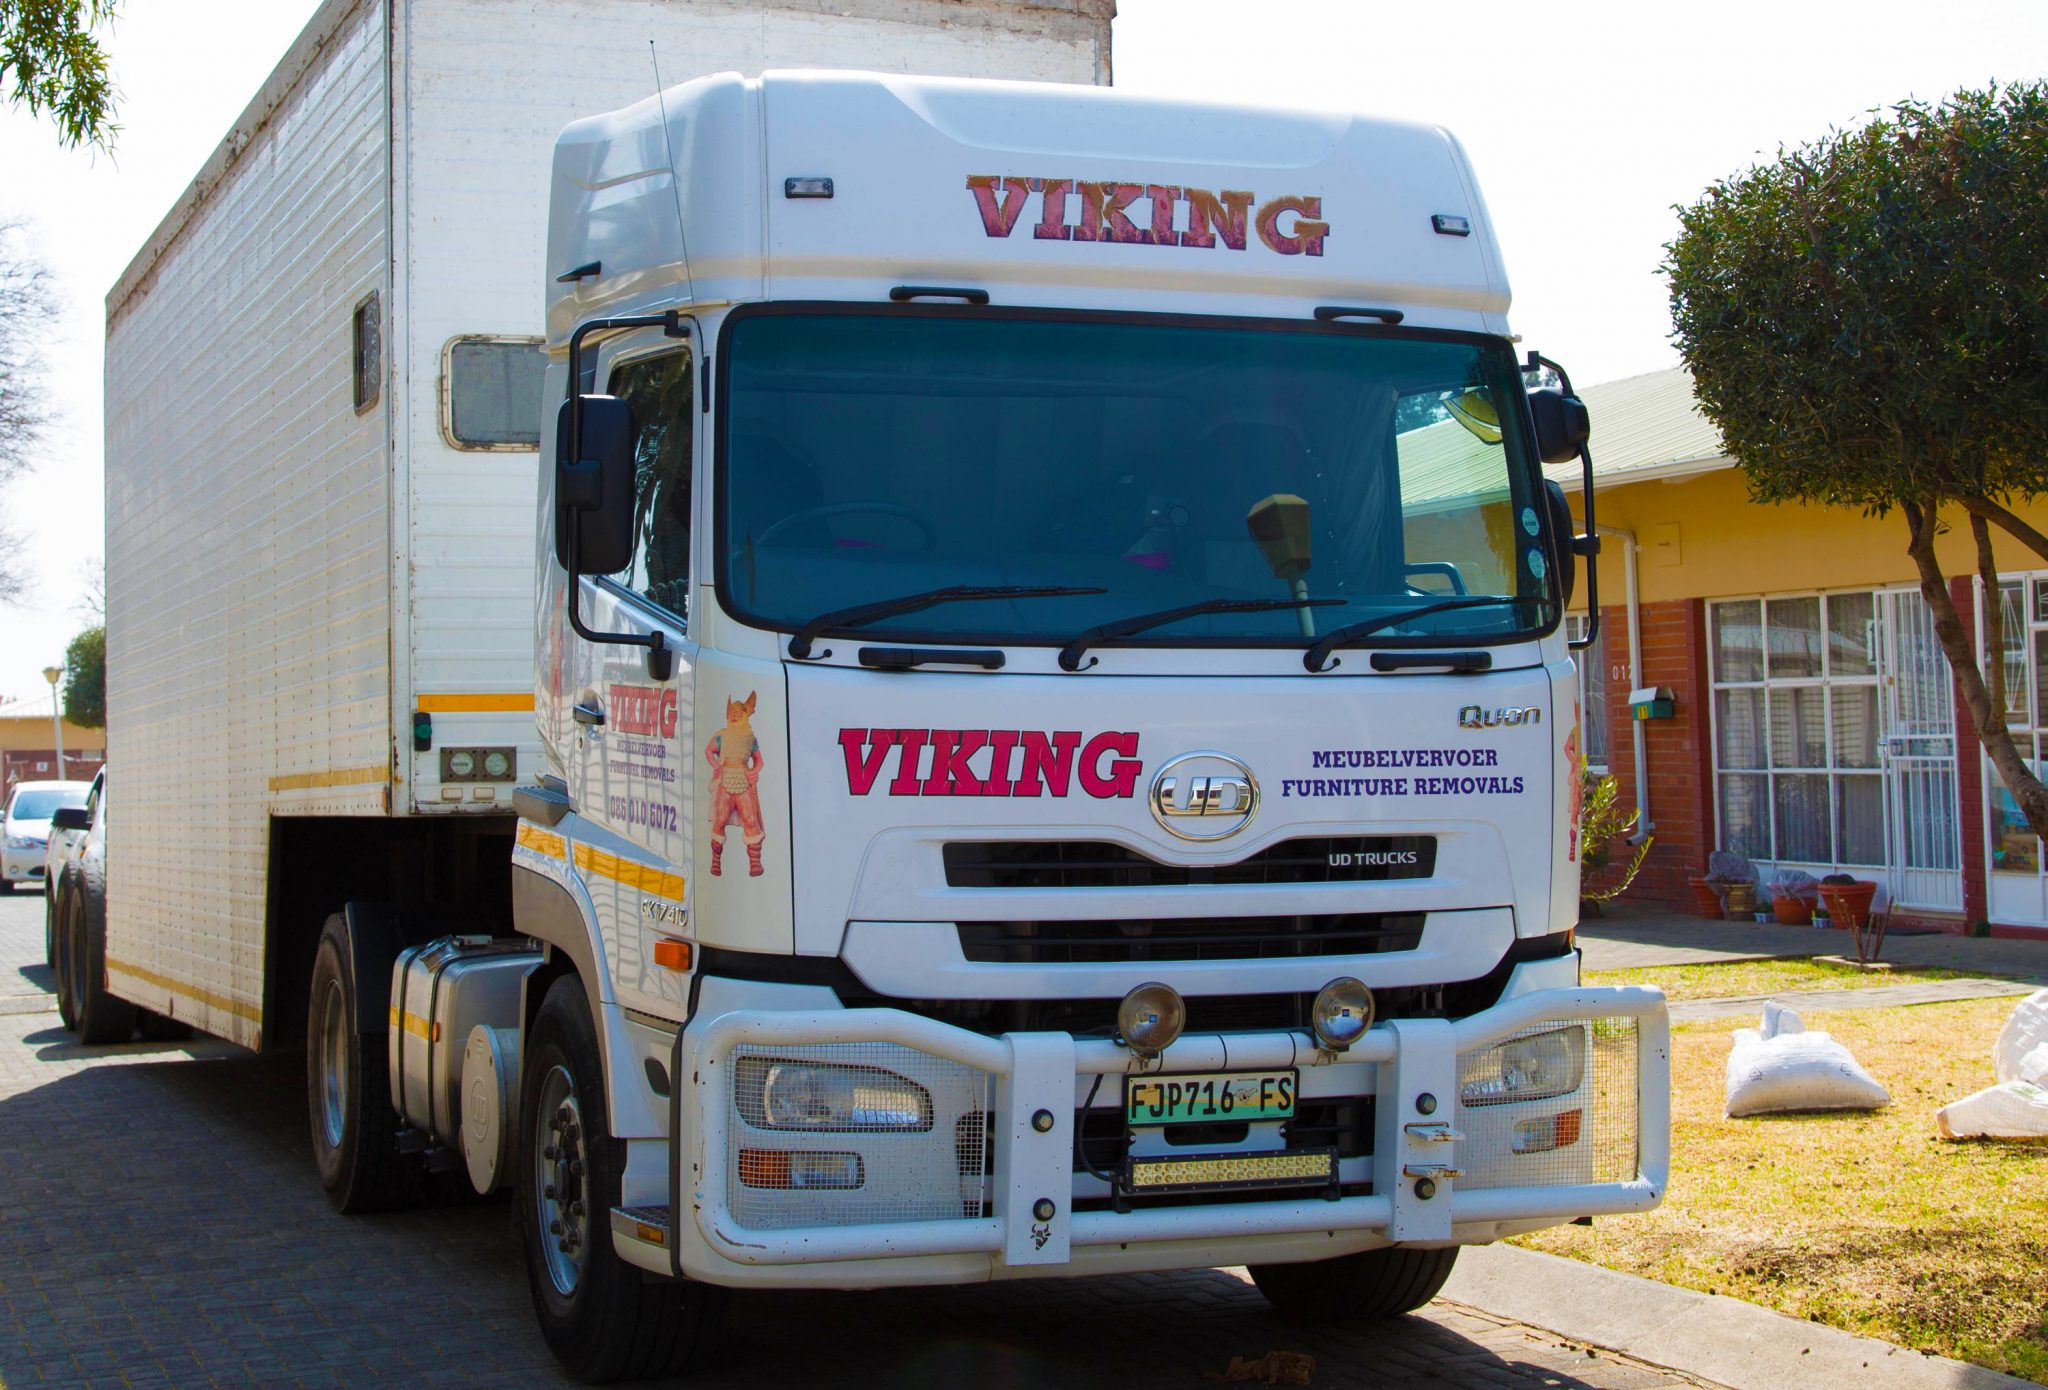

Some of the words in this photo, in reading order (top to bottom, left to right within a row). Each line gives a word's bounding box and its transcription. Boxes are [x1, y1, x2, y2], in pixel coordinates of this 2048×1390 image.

[966, 174, 1329, 257] VIKING
[610, 684, 677, 739] VIKING
[1458, 704, 1541, 730] Quon
[640, 764, 675, 783] REMOVALS
[838, 728, 1142, 798] VIKING
[1312, 749, 1498, 768] MEUBELVERVOER
[1159, 776, 1251, 816] UD
[1282, 779, 1408, 797] FURNITURE
[1414, 776, 1524, 795] REMOVALS
[610, 795, 626, 821] 086
[629, 799, 647, 825] 010
[650, 802, 677, 832] 6072
[1329, 853, 1351, 866] UD
[1354, 851, 1417, 865] TRUCKS
[1260, 1077, 1292, 1112] FS
